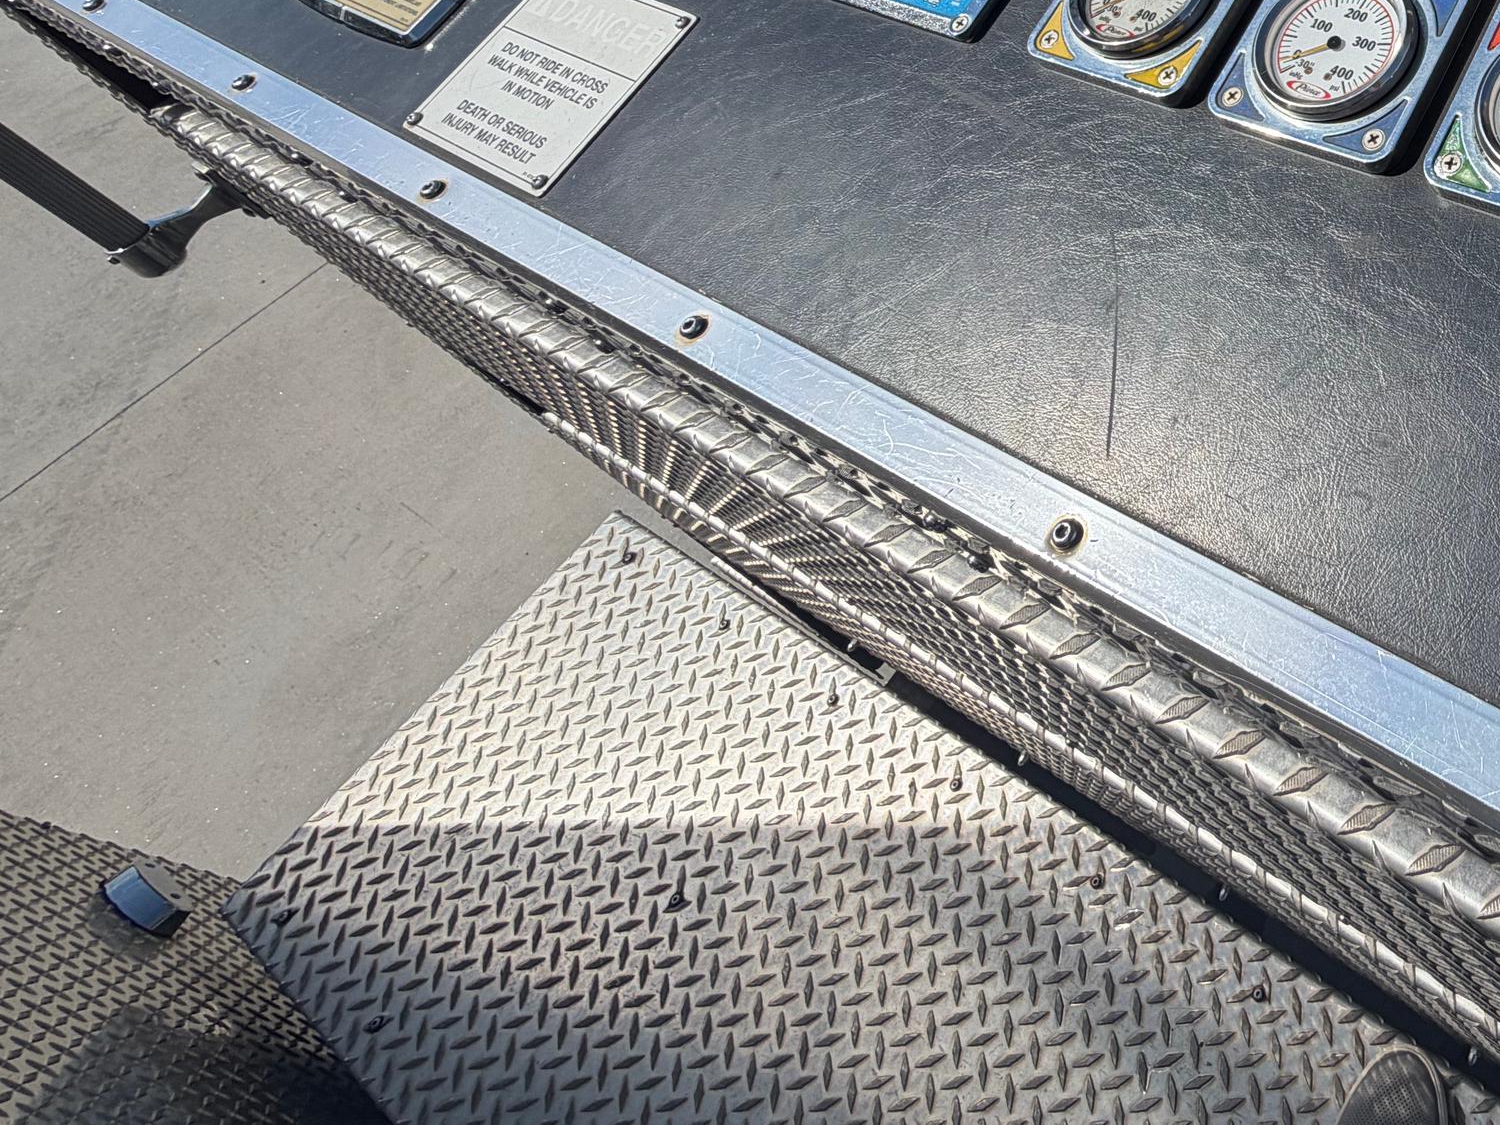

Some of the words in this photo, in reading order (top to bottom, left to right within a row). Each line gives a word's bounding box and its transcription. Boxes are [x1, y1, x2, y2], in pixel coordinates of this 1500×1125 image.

[1311, 19, 1333, 32] 100
[1344, 8, 1368, 22] 200
[1352, 36, 1376, 51] 300
[488, 54, 514, 75] WALK
[514, 65, 544, 87] WHILE
[545, 78, 586, 105] VEHICLE
[585, 95, 598, 109] IS
[501, 41, 519, 55] DO
[518, 47, 540, 64] NOT
[536, 56, 562, 75] RIDE
[562, 65, 575, 78] IN
[570, 70, 609, 95] CROSS
[501, 80, 514, 93] IN
[512, 86, 555, 110] MOTION
[441, 113, 477, 136] INJURY
[474, 128, 498, 146] MAY
[498, 138, 537, 164] RESULT
[456, 99, 489, 120] DEATH
[486, 112, 504, 127] OR
[501, 119, 548, 150] SERIOUS
